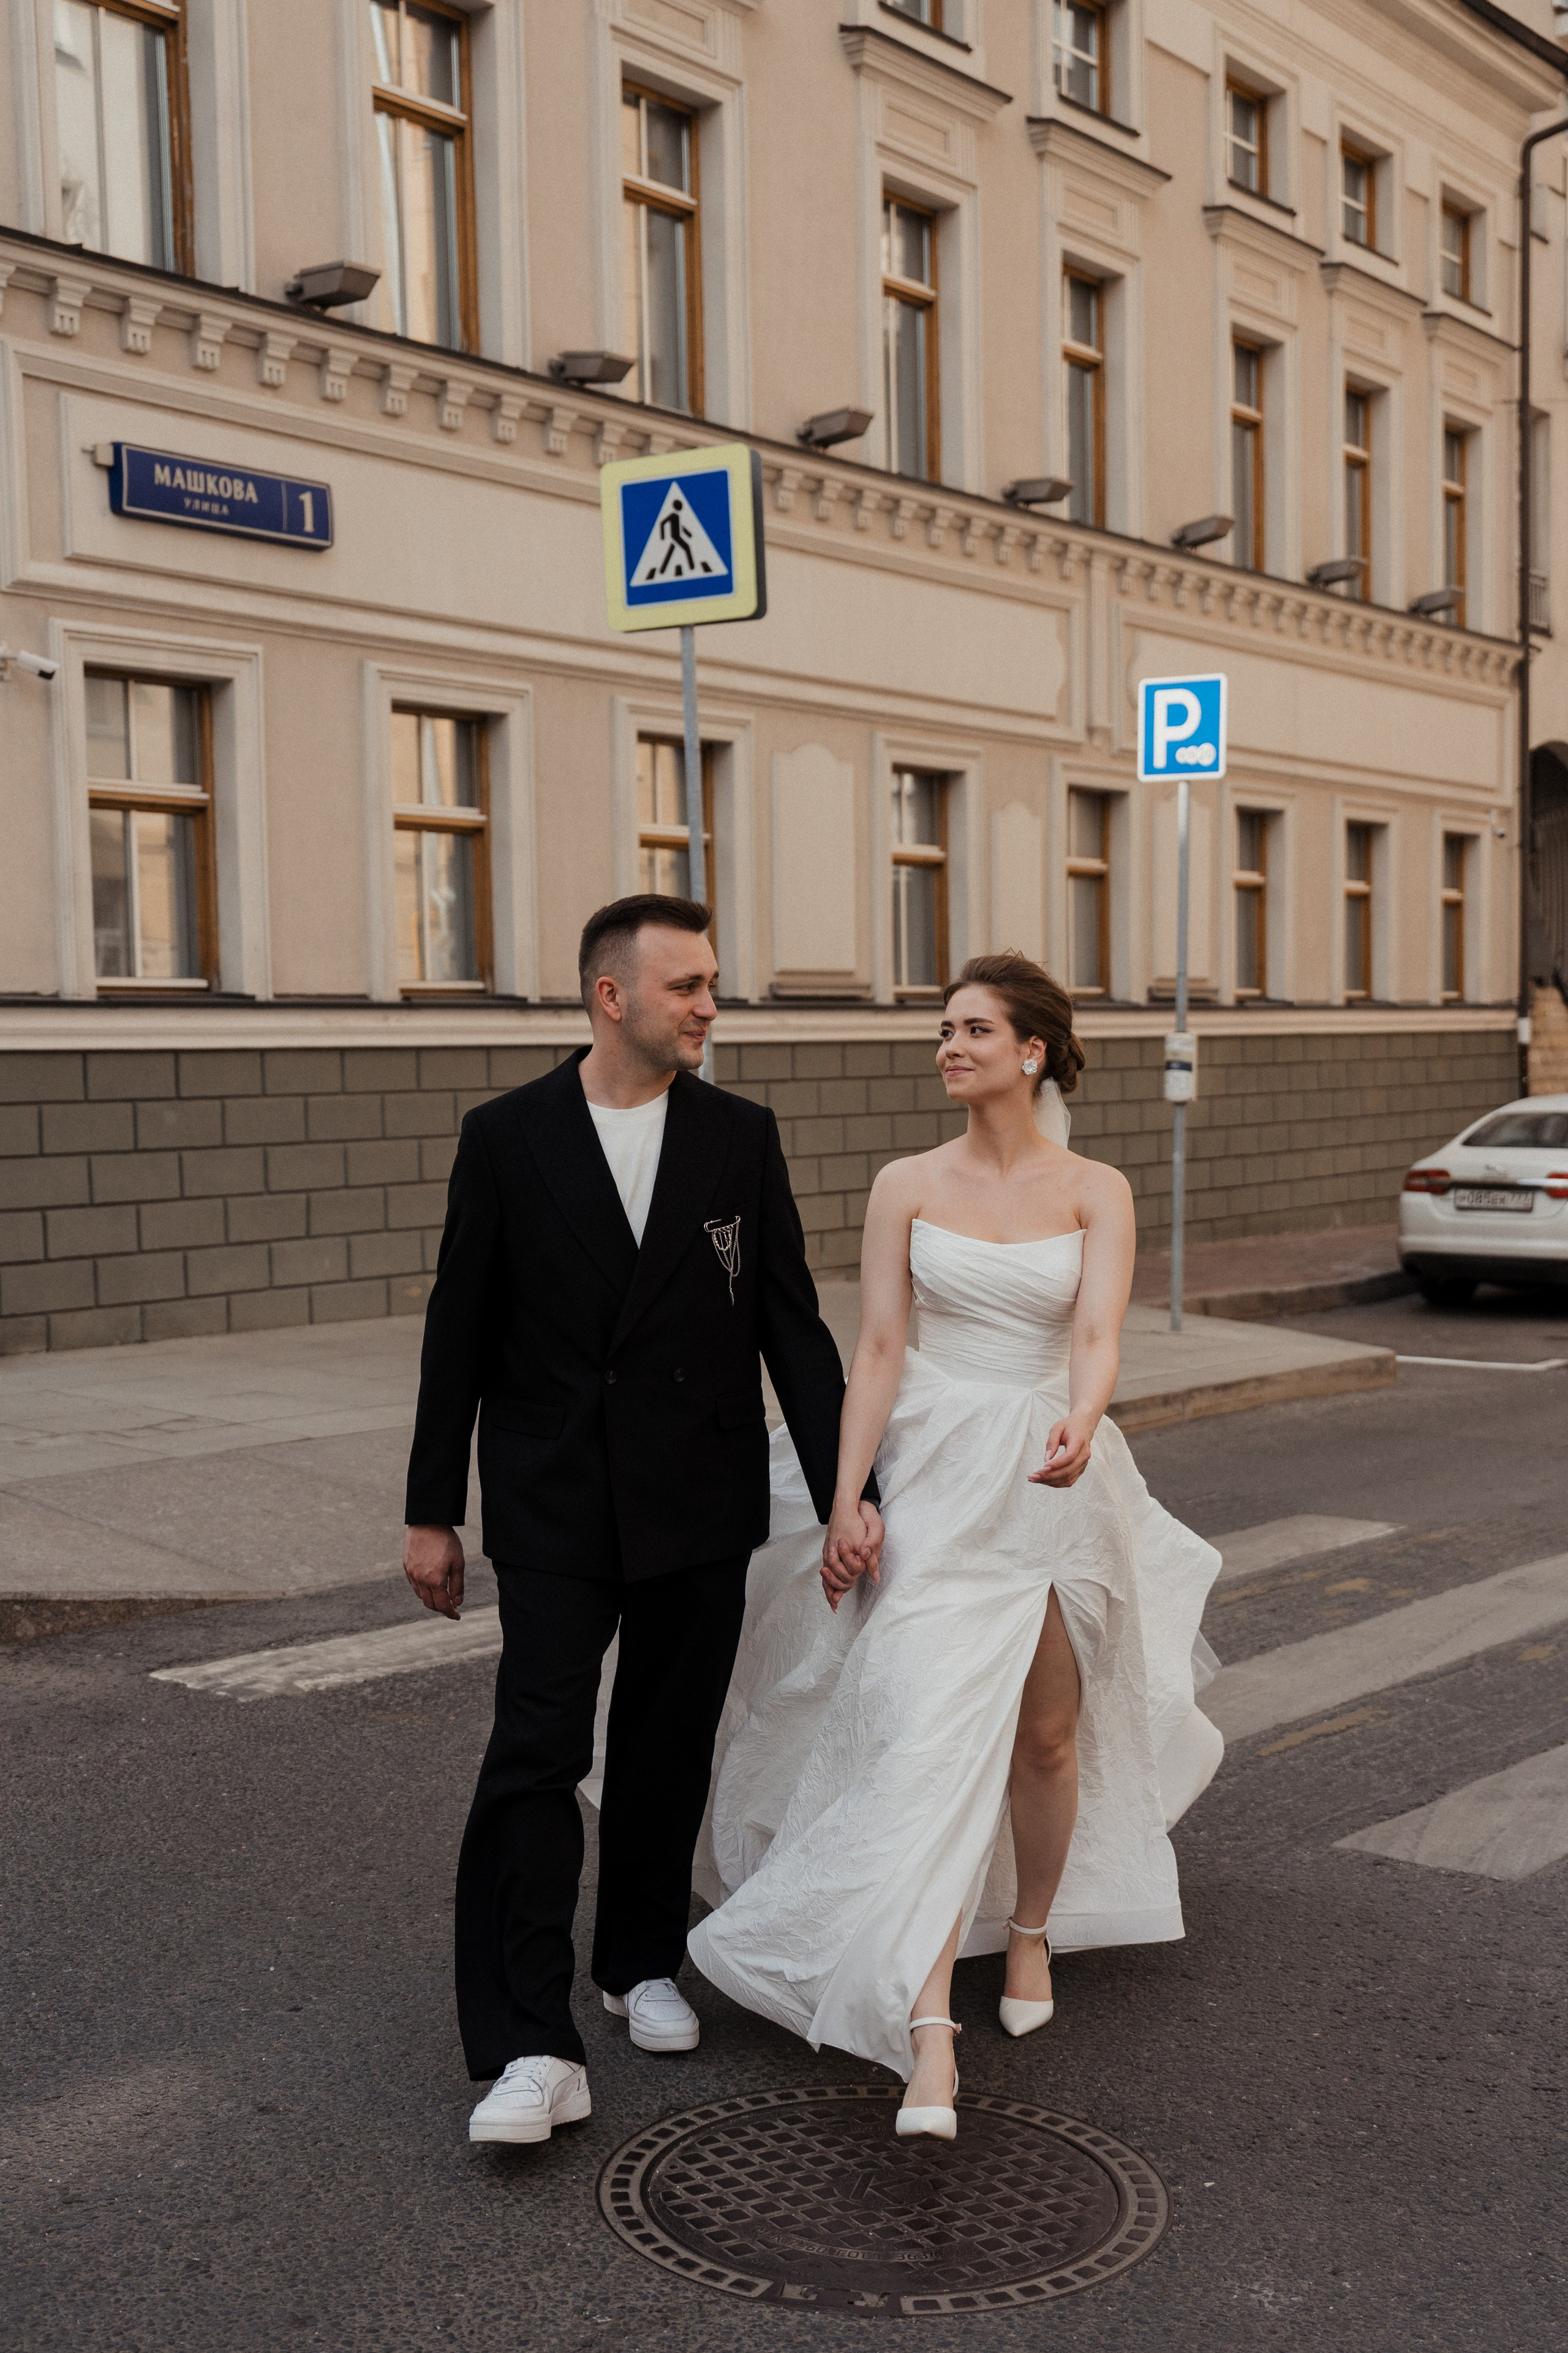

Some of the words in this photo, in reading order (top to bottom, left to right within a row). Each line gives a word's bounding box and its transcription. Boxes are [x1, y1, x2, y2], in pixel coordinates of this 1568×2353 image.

[154, 463, 258, 504] МАШКОВА
[183, 497, 230, 516] УЛИЦА
[298, 491, 315, 533] 1
[1153, 688, 1202, 769] P
